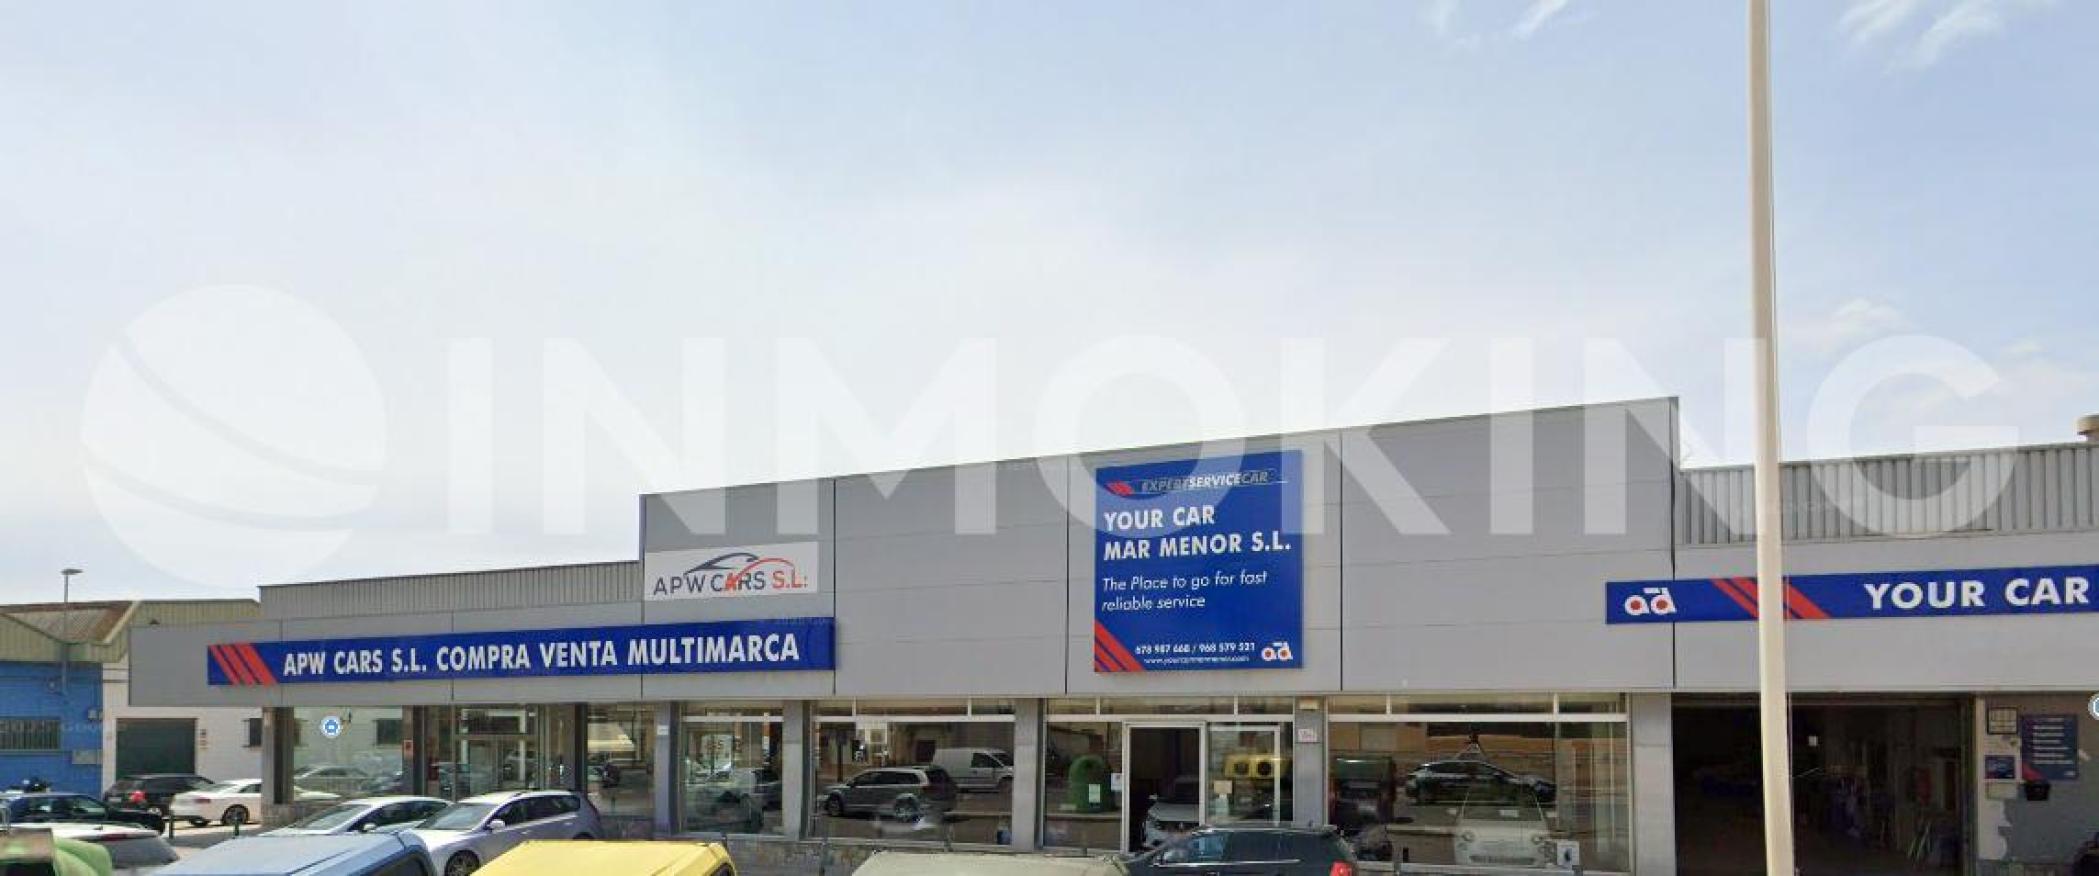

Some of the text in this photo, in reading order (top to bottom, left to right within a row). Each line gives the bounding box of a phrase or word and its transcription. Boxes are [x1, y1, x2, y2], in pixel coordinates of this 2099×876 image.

[1103, 504, 1215, 532] YOUR CAR
[1103, 530, 1292, 561] MAR MENOR S.L.
[653, 574, 706, 596] APW
[710, 570, 766, 593] CARS
[1102, 569, 1268, 592] The Place to go for fast
[1864, 576, 2089, 610] YOUR CAR
[1101, 595, 1206, 612] reliable service
[284, 633, 800, 677] APW CARS S.L. COMPRA VENTA MULTIMARCA
